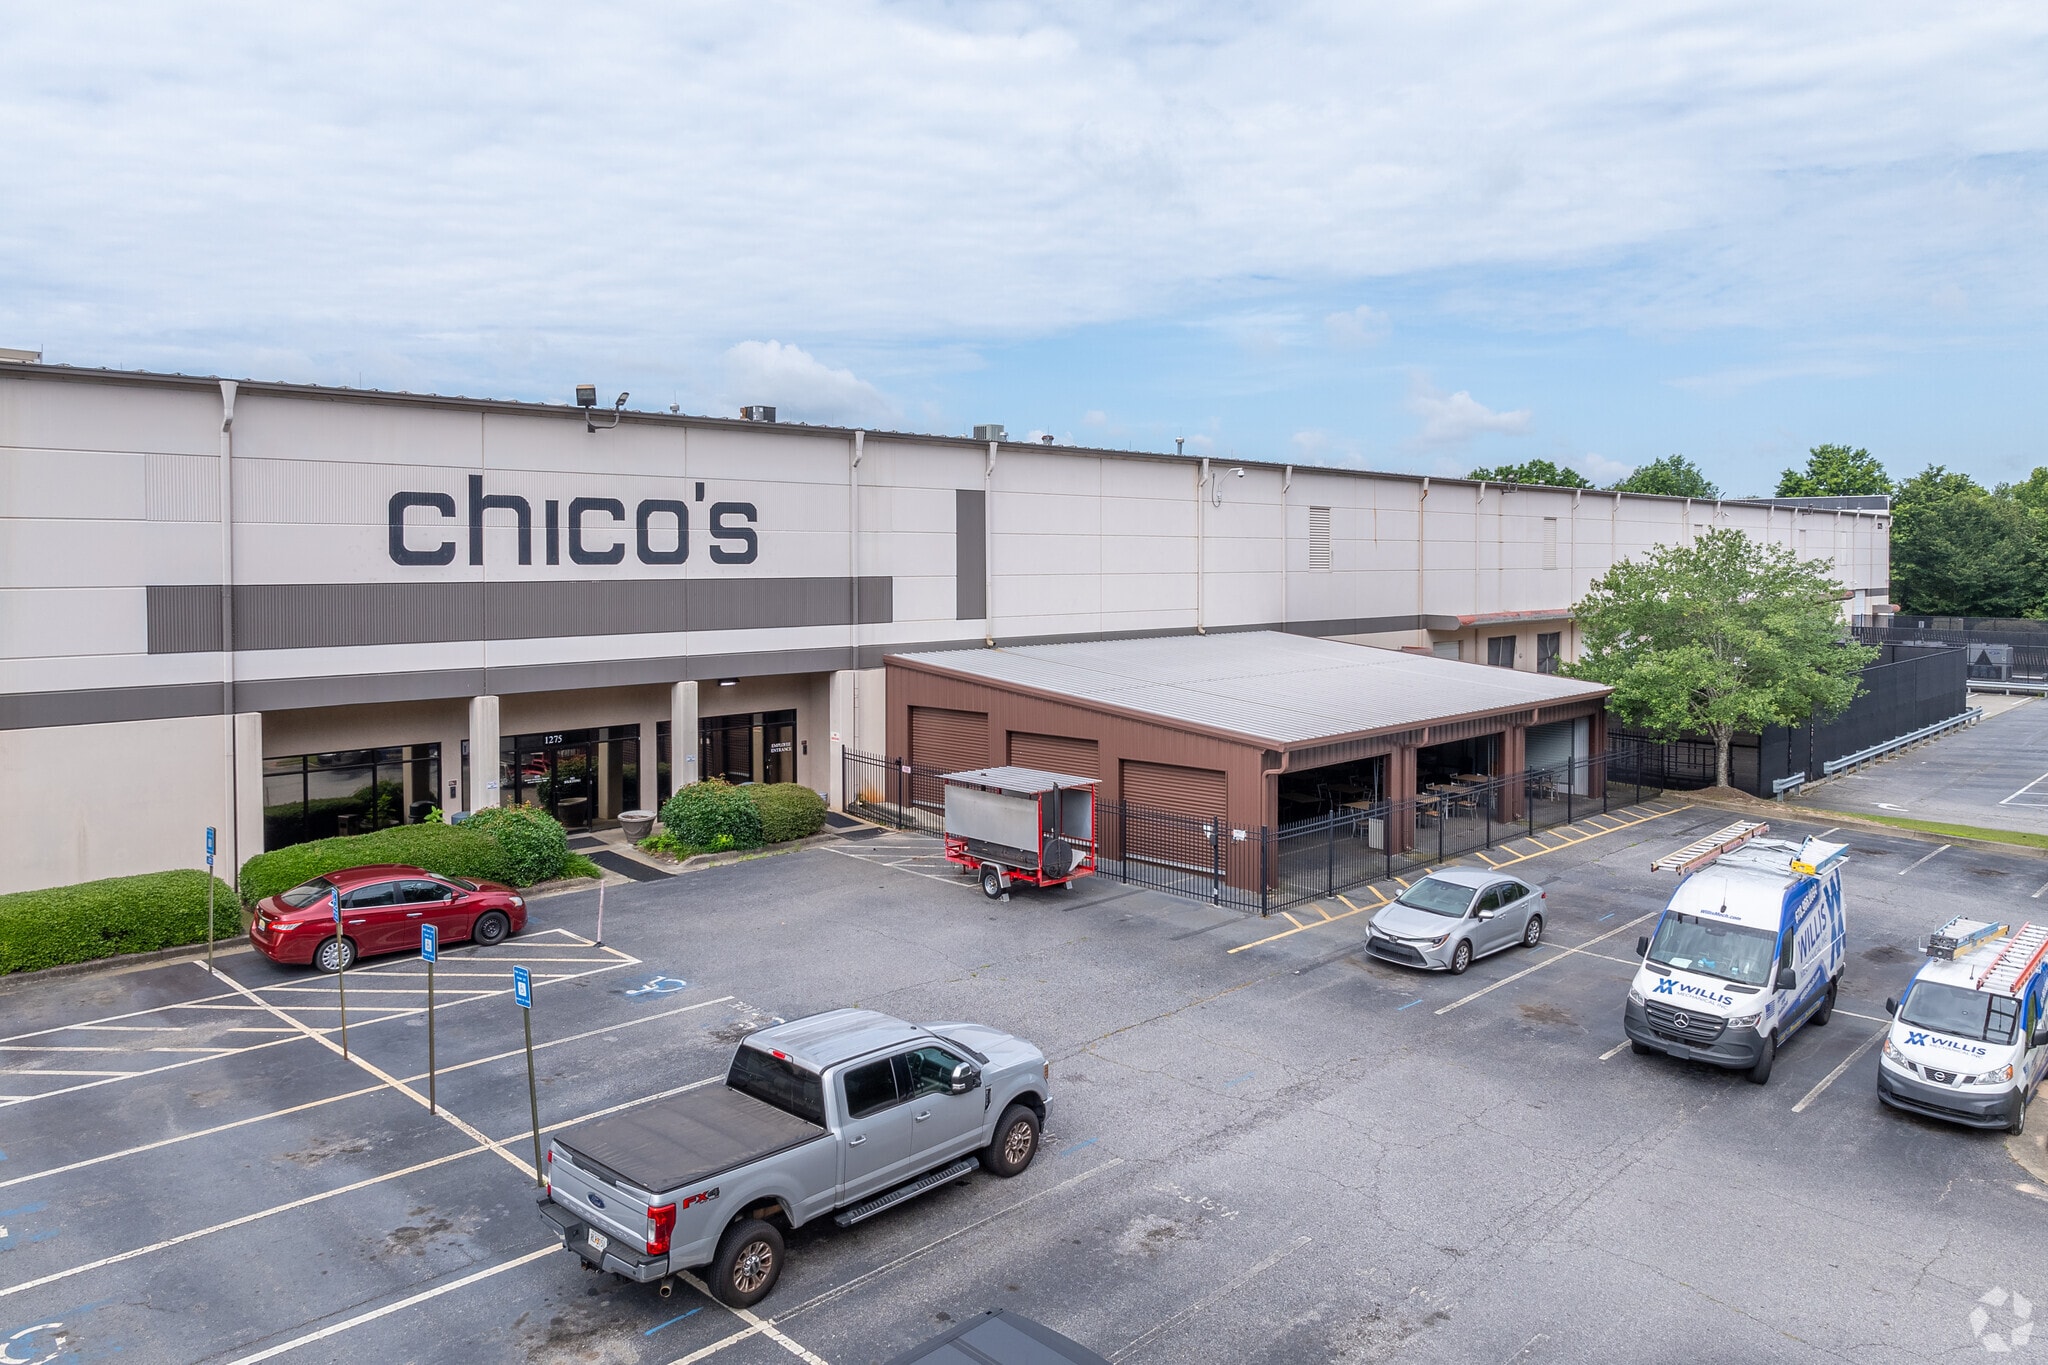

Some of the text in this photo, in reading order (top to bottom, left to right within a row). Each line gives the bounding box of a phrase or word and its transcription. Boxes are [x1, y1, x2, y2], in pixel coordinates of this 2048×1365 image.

[389, 475, 758, 566] chico's
[544, 735, 563, 745] 1275
[1798, 903, 1827, 963] WILLIS
[1677, 991, 1715, 1006] MECHANICAL
[1680, 984, 1733, 1005] WILLIS
[1931, 1037, 1987, 1056] WILLIS
[683, 1187, 720, 1210] FX4
